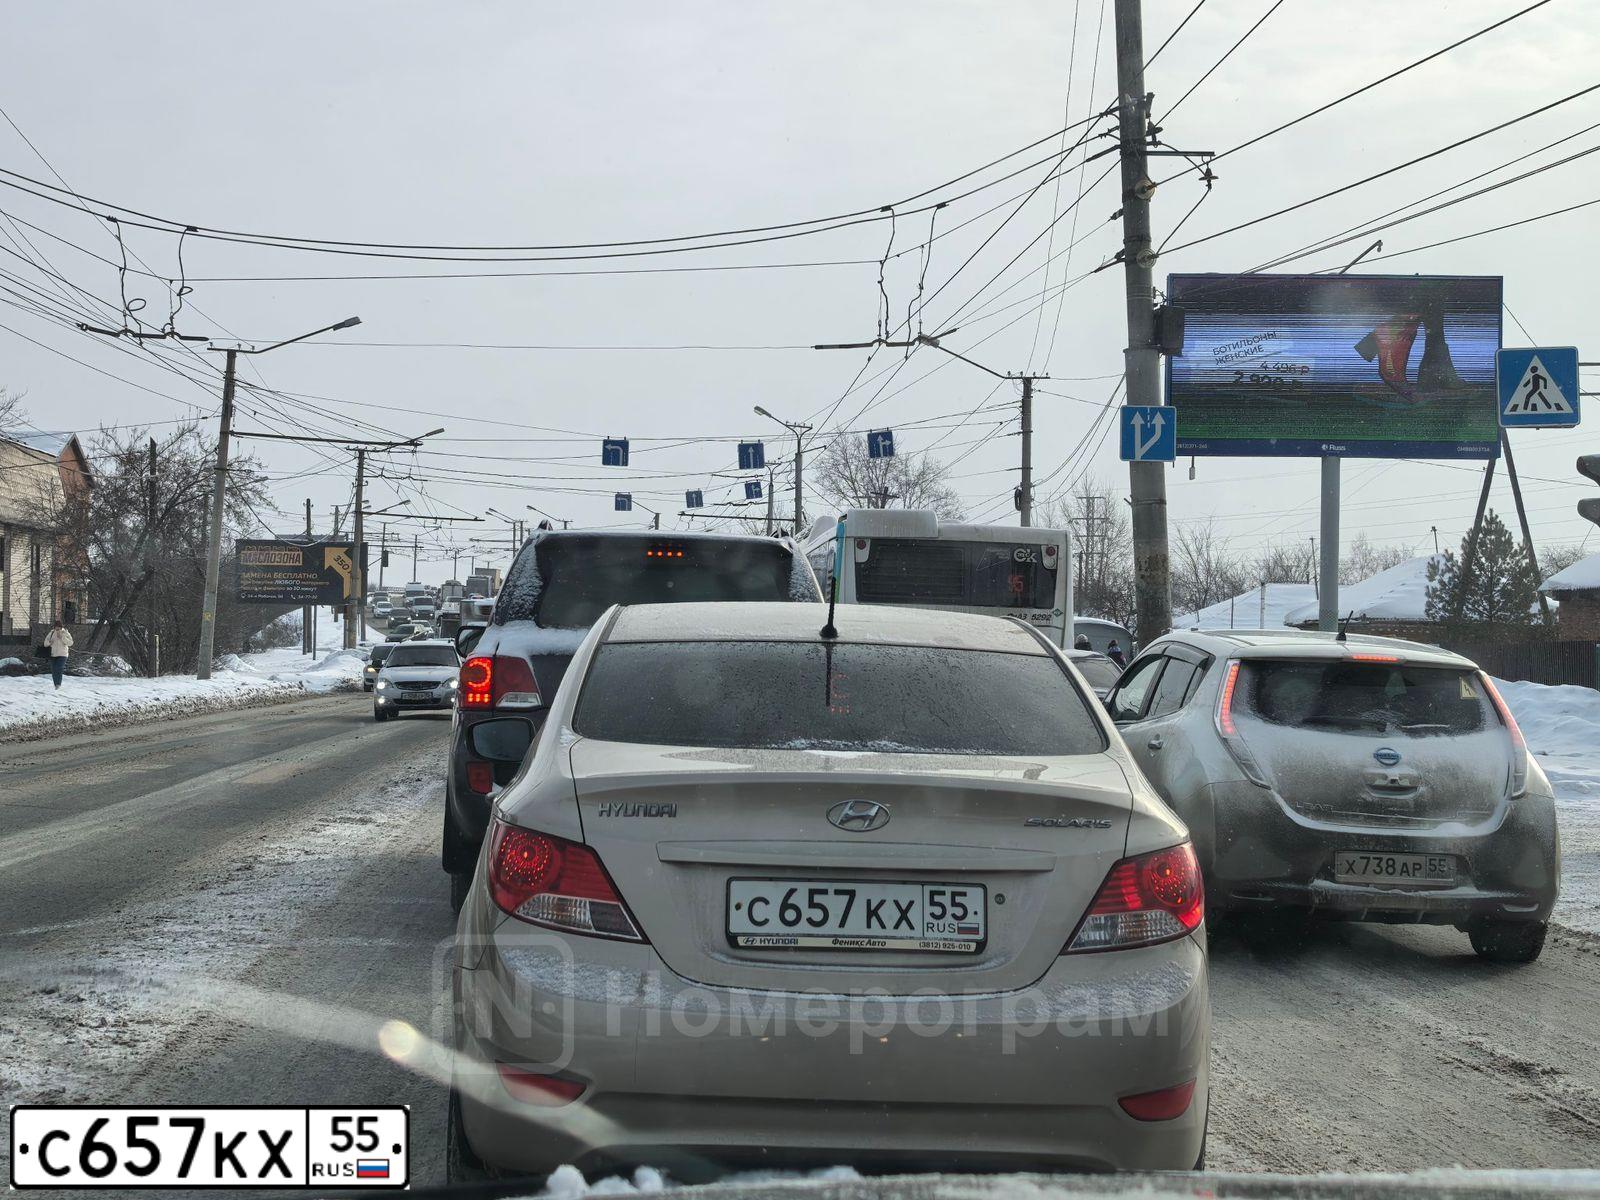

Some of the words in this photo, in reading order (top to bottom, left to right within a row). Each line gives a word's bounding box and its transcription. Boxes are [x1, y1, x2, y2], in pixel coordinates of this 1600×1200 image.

[1212, 331, 1277, 356] БОТИЛЬОНЫ
[1214, 344, 1265, 366] ЖЕНСКИЕ
[1031, 613, 1052, 621] 5292
[598, 802, 677, 818] HYUNDAI
[1023, 817, 1112, 829] SOLARIS
[1344, 856, 1423, 877] Х738АР
[1428, 858, 1447, 873] 55
[747, 887, 915, 931] С657КХ
[929, 890, 969, 921] 55
[926, 922, 956, 934] RUS
[759, 938, 799, 946] HYUNDAI
[831, 938, 865, 947] Феникс
[865, 939, 887, 947] Авто
